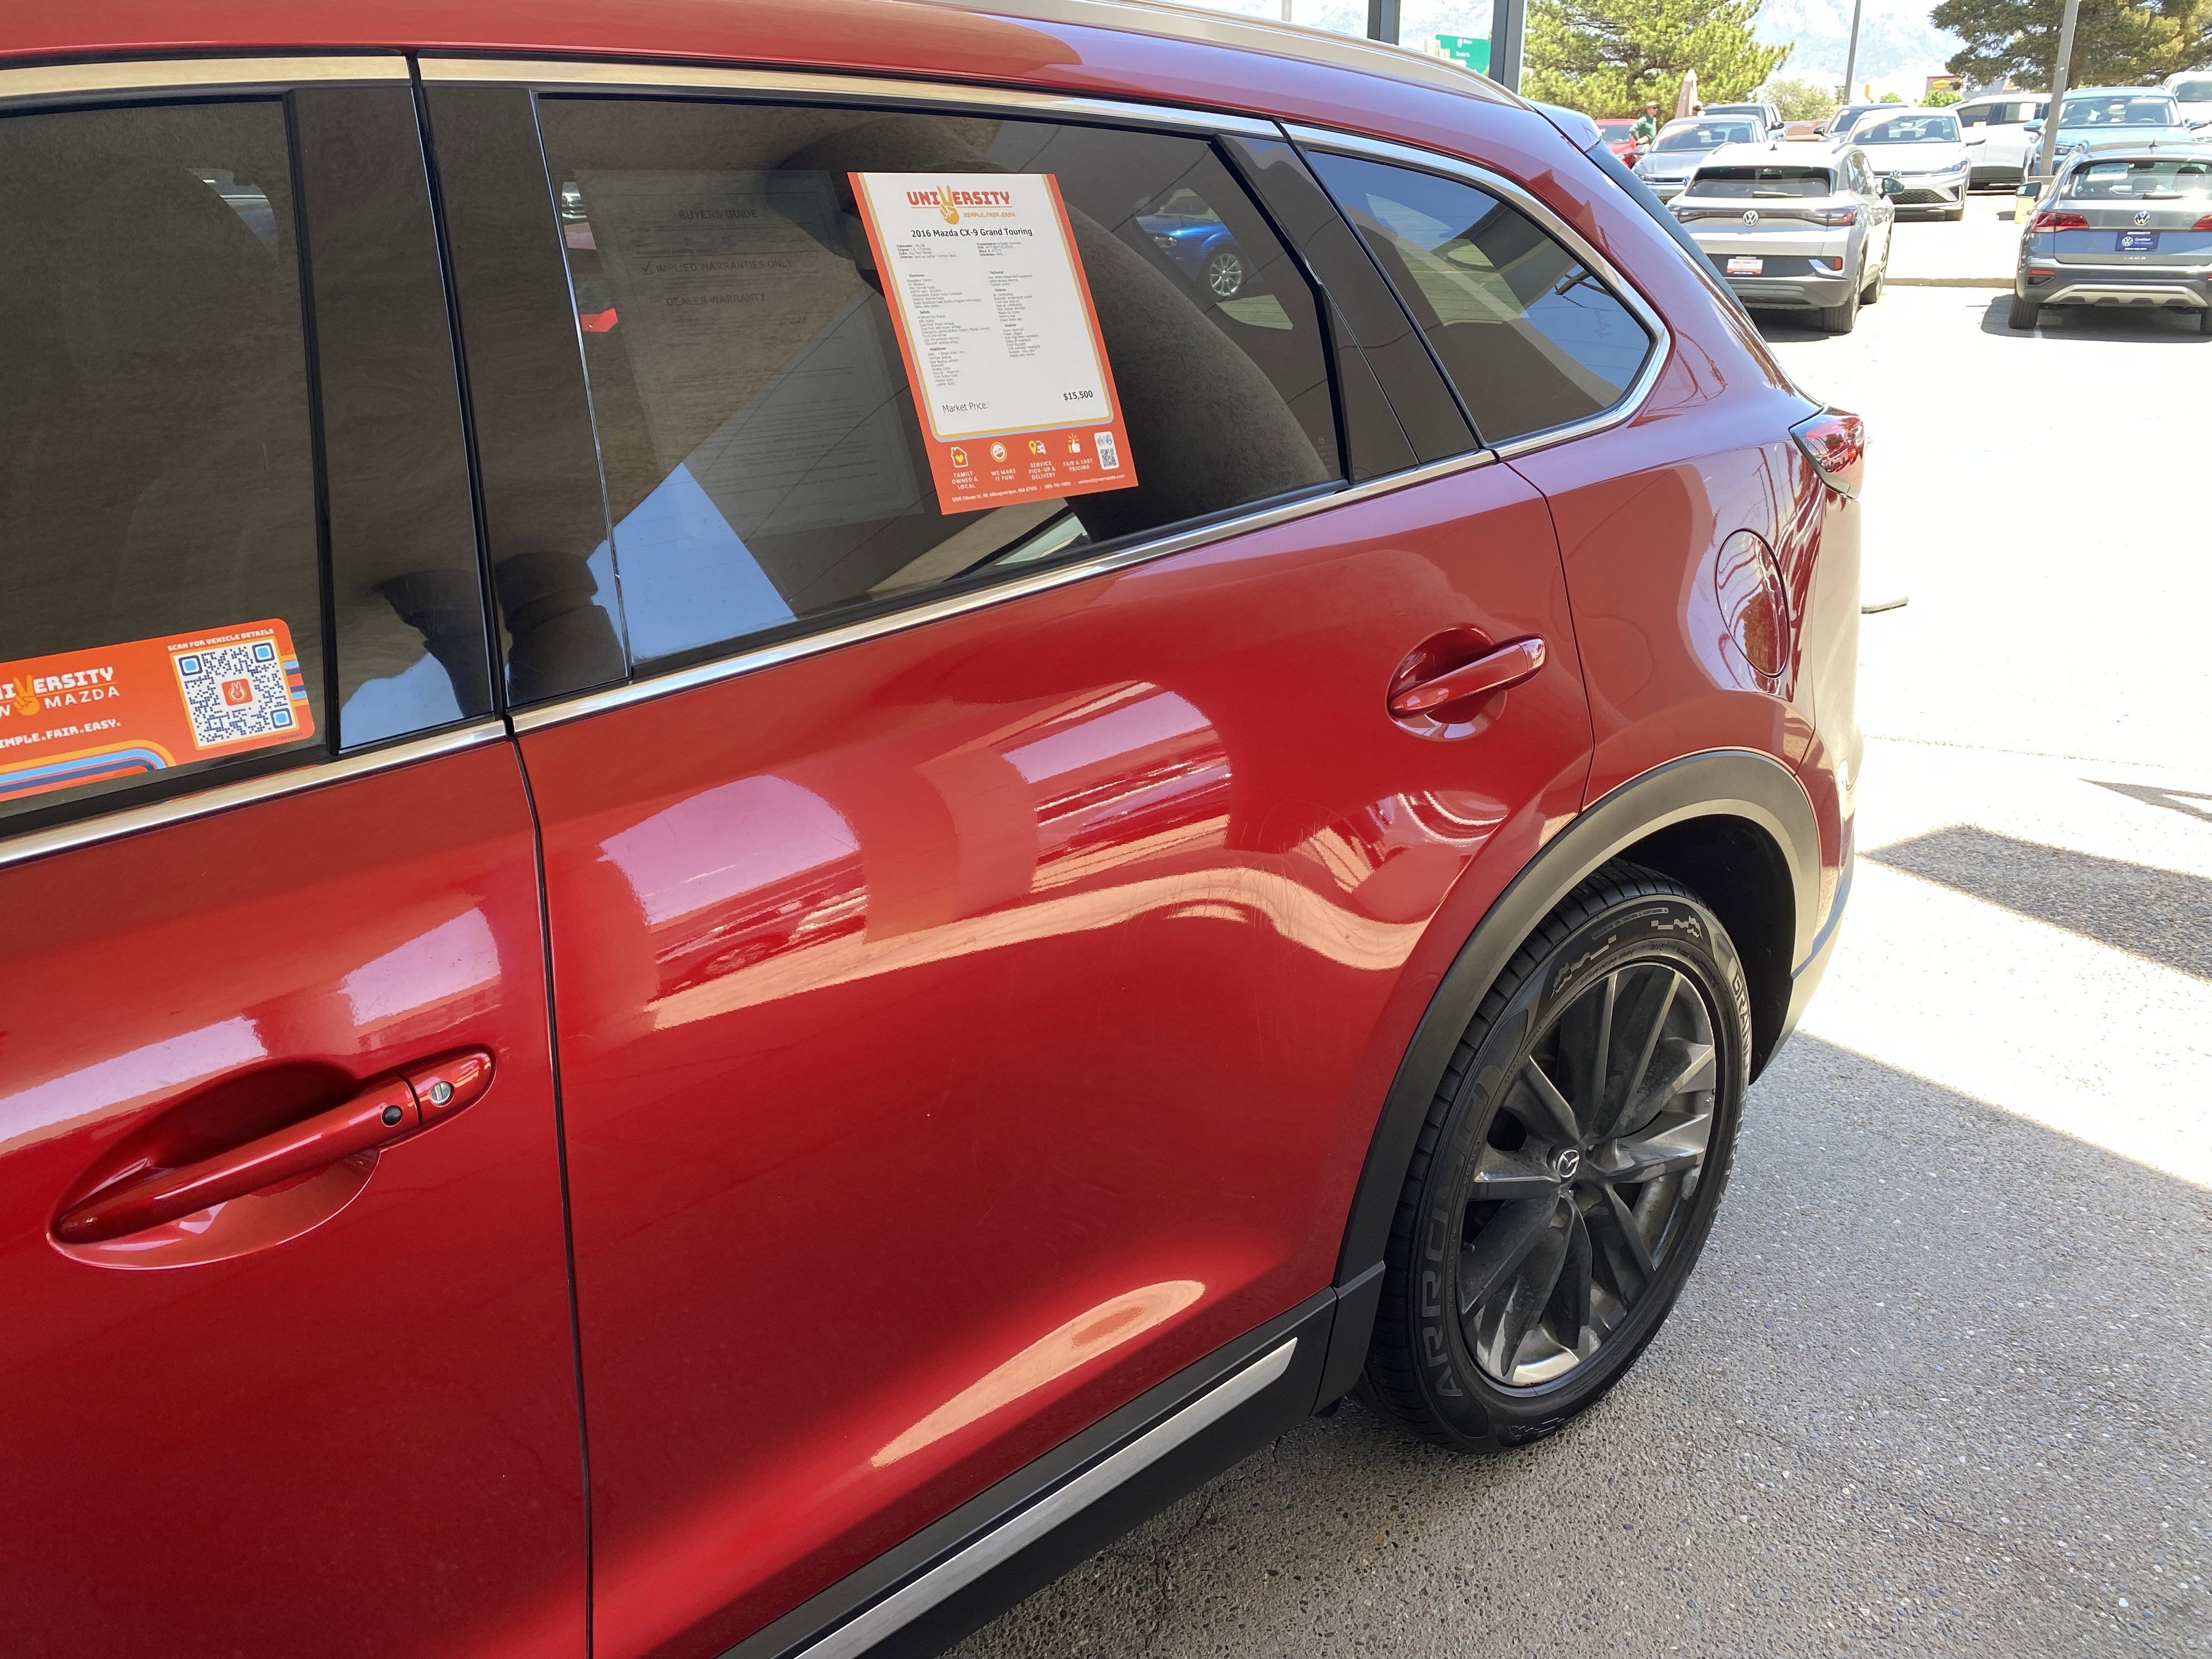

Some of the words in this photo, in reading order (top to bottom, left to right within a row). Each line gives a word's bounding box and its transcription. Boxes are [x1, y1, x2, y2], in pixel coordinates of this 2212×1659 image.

[678, 210, 723, 221] BUYERS
[725, 208, 759, 218] GUIDE
[911, 229, 932, 238] 2016
[933, 228, 958, 237] Mazda
[960, 228, 978, 236] CX-9
[980, 228, 1003, 236] Grand
[1004, 227, 1033, 236] Touring
[654, 262, 697, 274] IMPLIED
[699, 260, 765, 272] WARRANTIES
[767, 258, 793, 269] ONLY
[666, 296, 708, 307] DEALER
[710, 293, 766, 305] WARRANTY
[1063, 390, 1093, 402] $15,500
[942, 403, 968, 413] Market
[968, 401, 989, 411] Price:
[989, 489, 1018, 498] Albuquerque,
[167, 642, 189, 652] SCAN
[189, 639, 206, 648] FOR
[206, 634, 240, 645] VEHICLE
[240, 628, 275, 640] DETAILS
[43, 686, 120, 709] MAZDA
